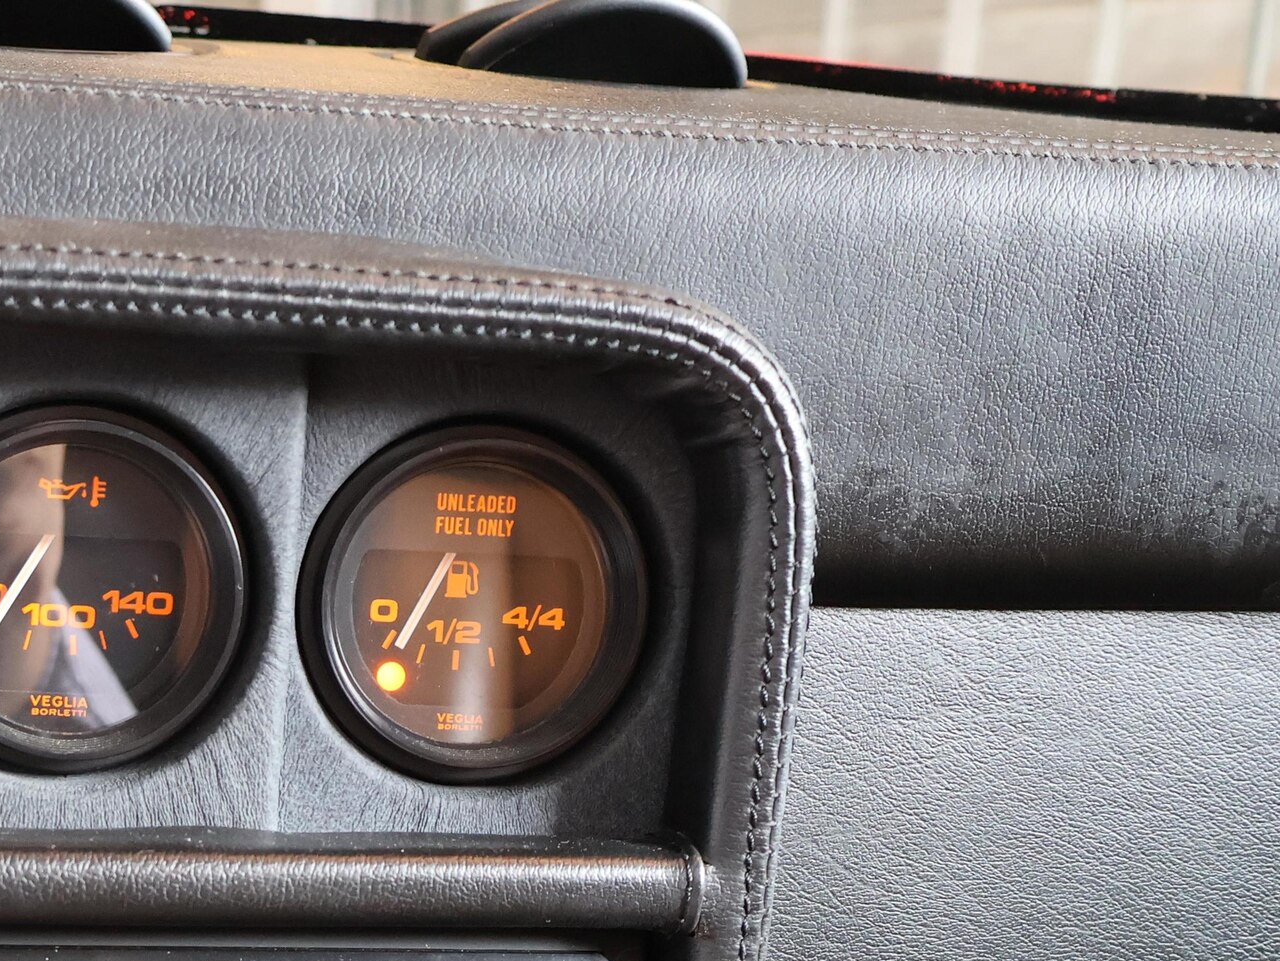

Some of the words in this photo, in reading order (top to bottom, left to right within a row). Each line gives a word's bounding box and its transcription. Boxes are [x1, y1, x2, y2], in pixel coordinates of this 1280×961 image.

[436, 492, 517, 515] UNLEADED
[435, 516, 473, 536] FUEL
[476, 518, 515, 538] ONLY
[102, 590, 174, 616] 140
[370, 598, 399, 623] 0
[21, 602, 96, 629] 100
[502, 604, 565, 631] 4/4
[426, 617, 482, 645] 1/2
[30, 694, 88, 709] VEGLIA
[30, 708, 88, 718] BORLETTI
[437, 712, 483, 724] VEGLIA
